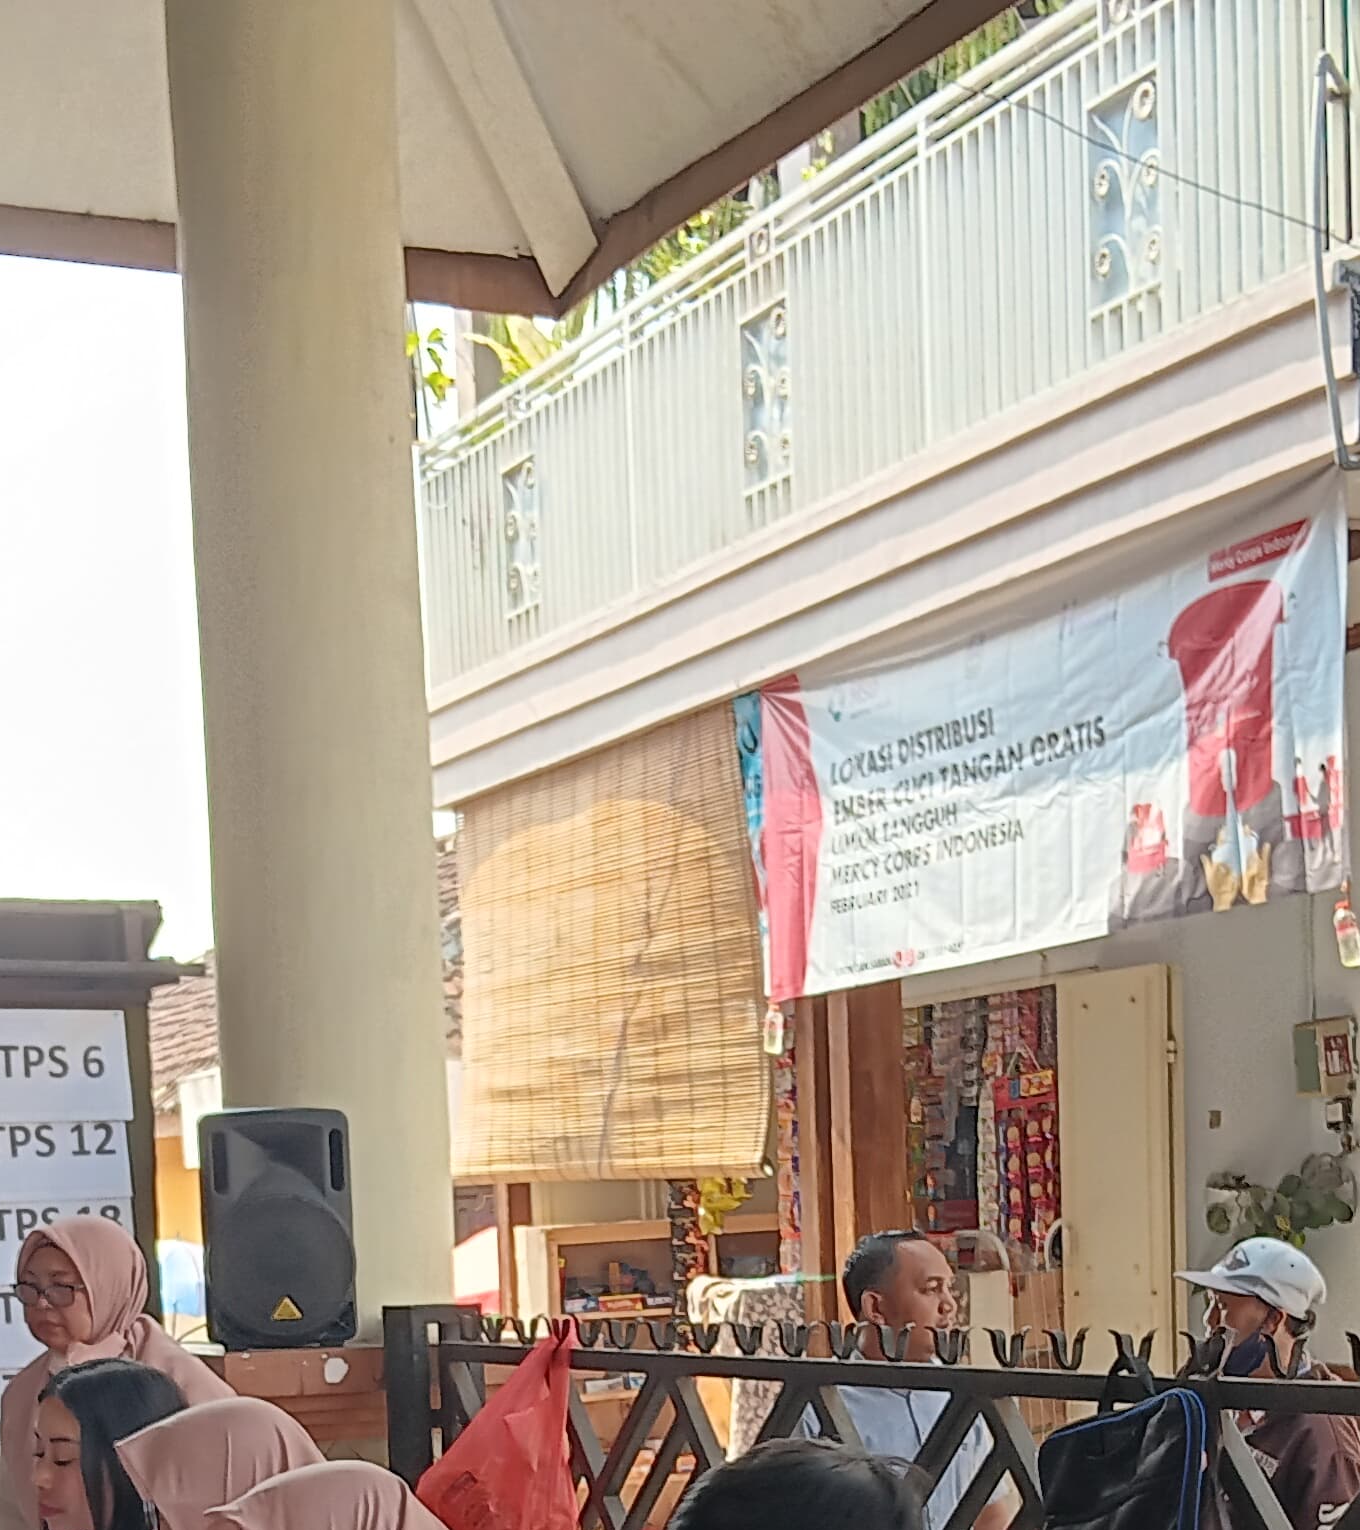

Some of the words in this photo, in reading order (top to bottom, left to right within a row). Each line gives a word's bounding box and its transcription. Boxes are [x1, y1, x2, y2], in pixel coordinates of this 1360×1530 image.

[830, 743, 893, 786] LOKASI
[898, 707, 995, 765] DISTRIBUSI
[939, 742, 1024, 787] TANGAN
[1030, 715, 1107, 767] GRATIS
[831, 858, 880, 887] MERCY
[884, 843, 932, 875] CORPS
[936, 818, 1025, 860] INDONESIA
[83, 1046, 104, 1078] 6
[71, 1121, 116, 1155] 12
